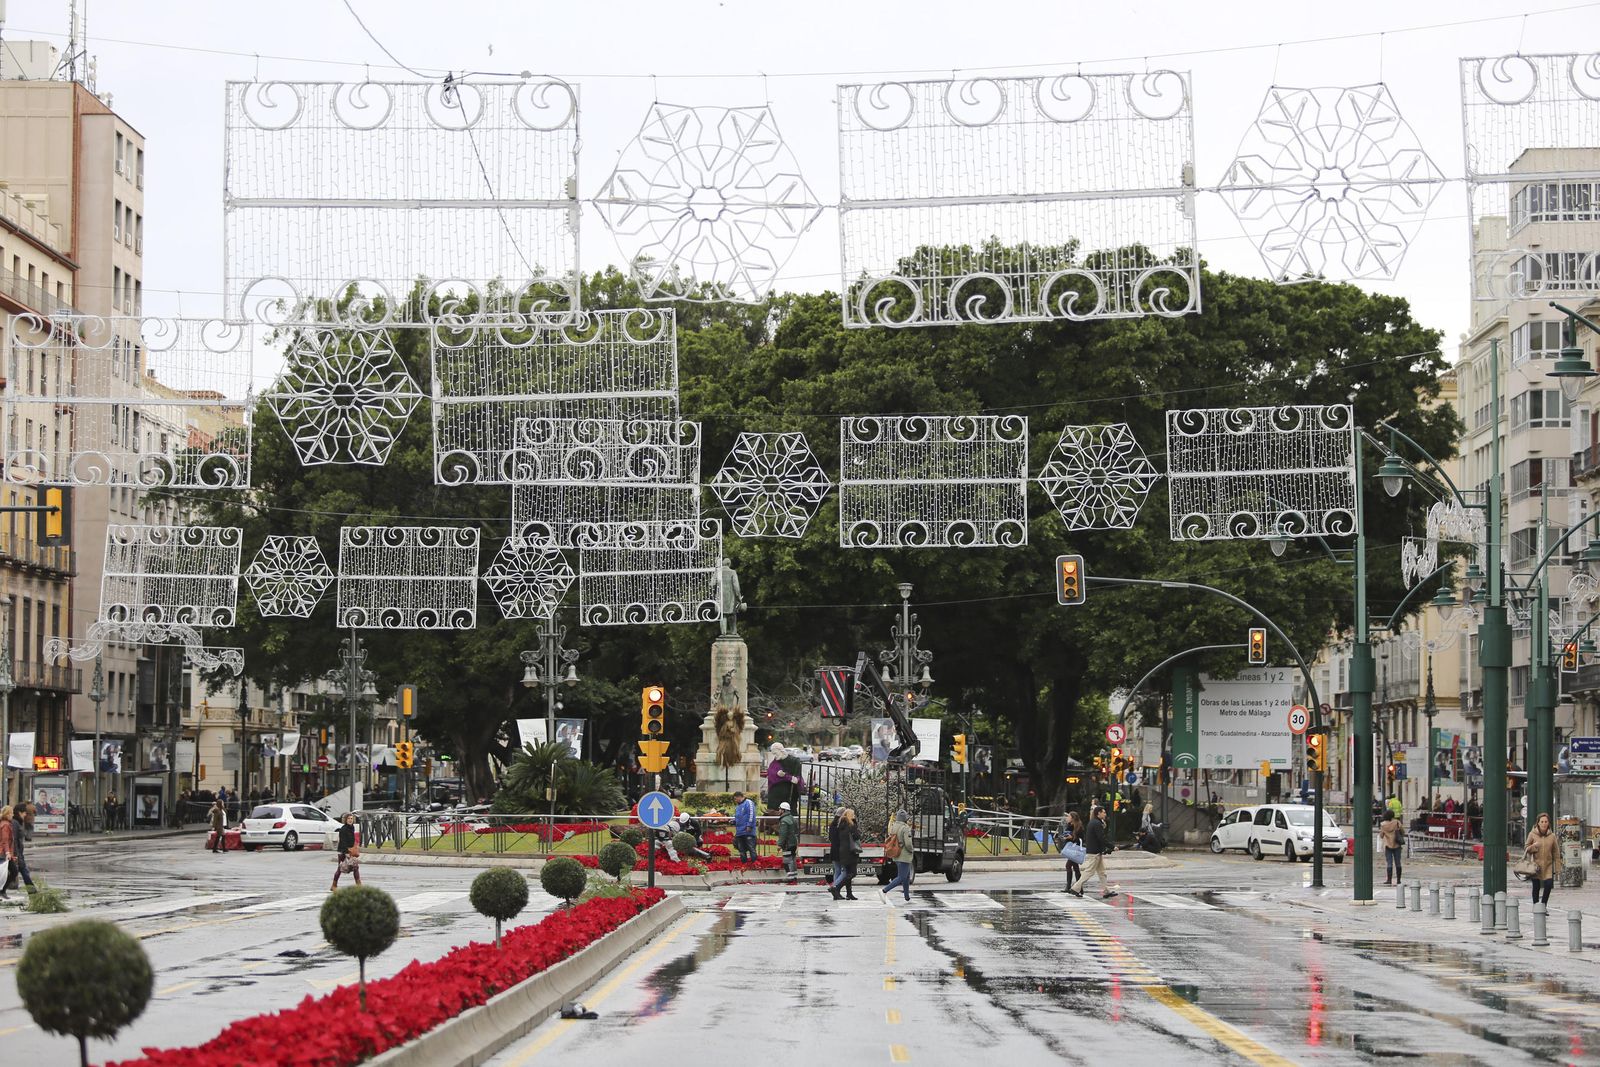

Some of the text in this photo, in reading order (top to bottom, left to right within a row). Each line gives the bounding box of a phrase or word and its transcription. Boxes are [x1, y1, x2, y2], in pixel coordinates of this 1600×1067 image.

[1270, 673, 1276, 683] y
[1278, 672, 1284, 681] 2
[1200, 698, 1220, 706] Obras
[1221, 698, 1230, 706] de
[1230, 698, 1240, 706] las
[1185, 705, 1193, 714] DE
[1185, 715, 1193, 733] JUNTA
[1292, 714, 1305, 725] 30
